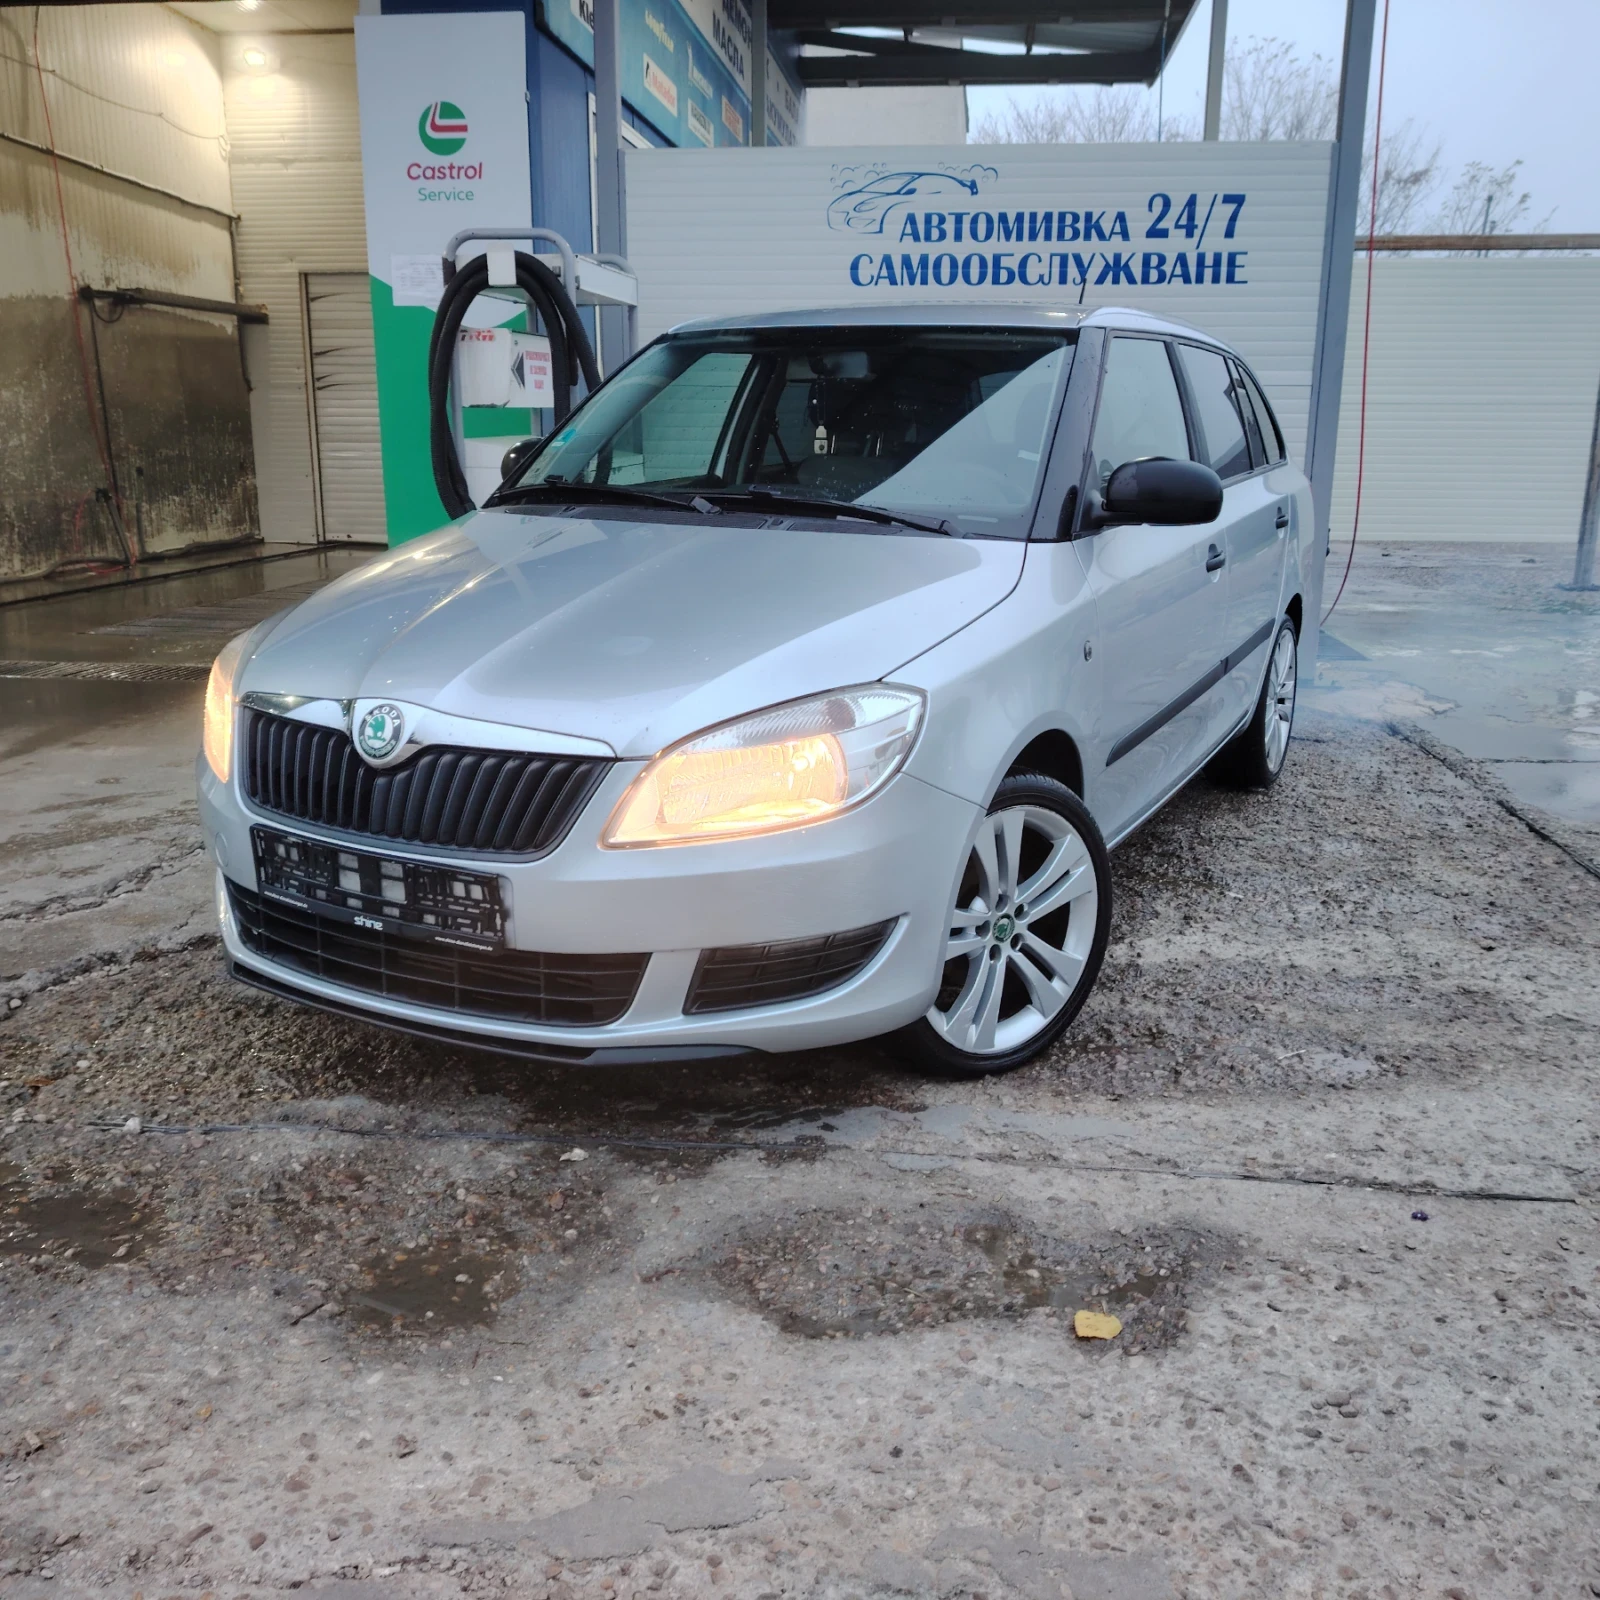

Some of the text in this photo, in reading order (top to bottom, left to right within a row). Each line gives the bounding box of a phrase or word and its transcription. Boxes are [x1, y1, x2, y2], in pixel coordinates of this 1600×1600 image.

[712, 9, 745, 81] МАСЛА
[407, 162, 483, 180] Castrol
[417, 187, 475, 202] Service
[899, 193, 1247, 249] АВТОМИВКА 24/7
[849, 251, 1249, 287] САМООБСЛУЖВАНЕ
[354, 915, 383, 931] shine
